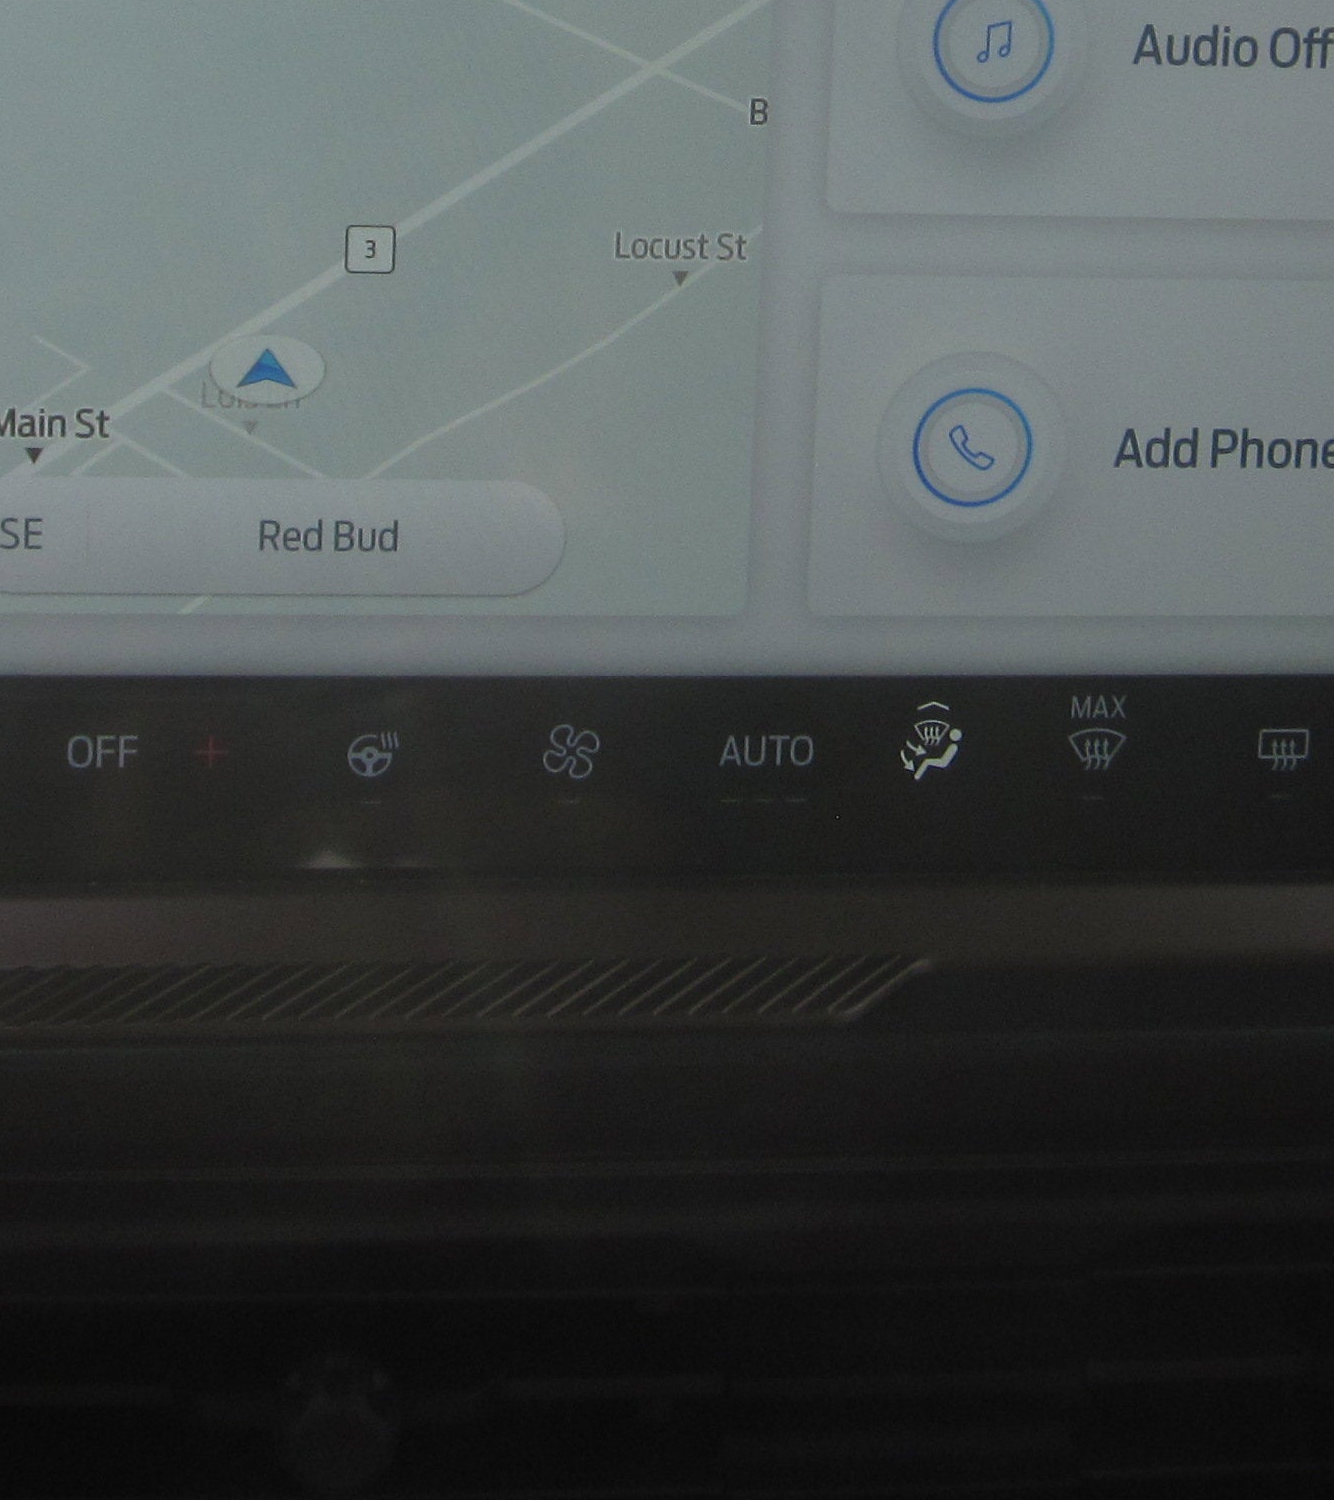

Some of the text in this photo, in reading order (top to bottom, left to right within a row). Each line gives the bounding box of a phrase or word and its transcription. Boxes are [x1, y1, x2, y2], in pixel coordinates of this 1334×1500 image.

[1131, 22, 1260, 69] Audio
[749, 97, 770, 127] B
[364, 238, 378, 261] 3
[614, 231, 748, 262] Locust St
[74, 407, 111, 440] St
[1112, 426, 1200, 470] Add
[258, 518, 325, 553] Red
[332, 519, 400, 554] Bud
[1069, 694, 1127, 719] MAX
[66, 733, 140, 770] OFF
[718, 733, 816, 768] AUTO
